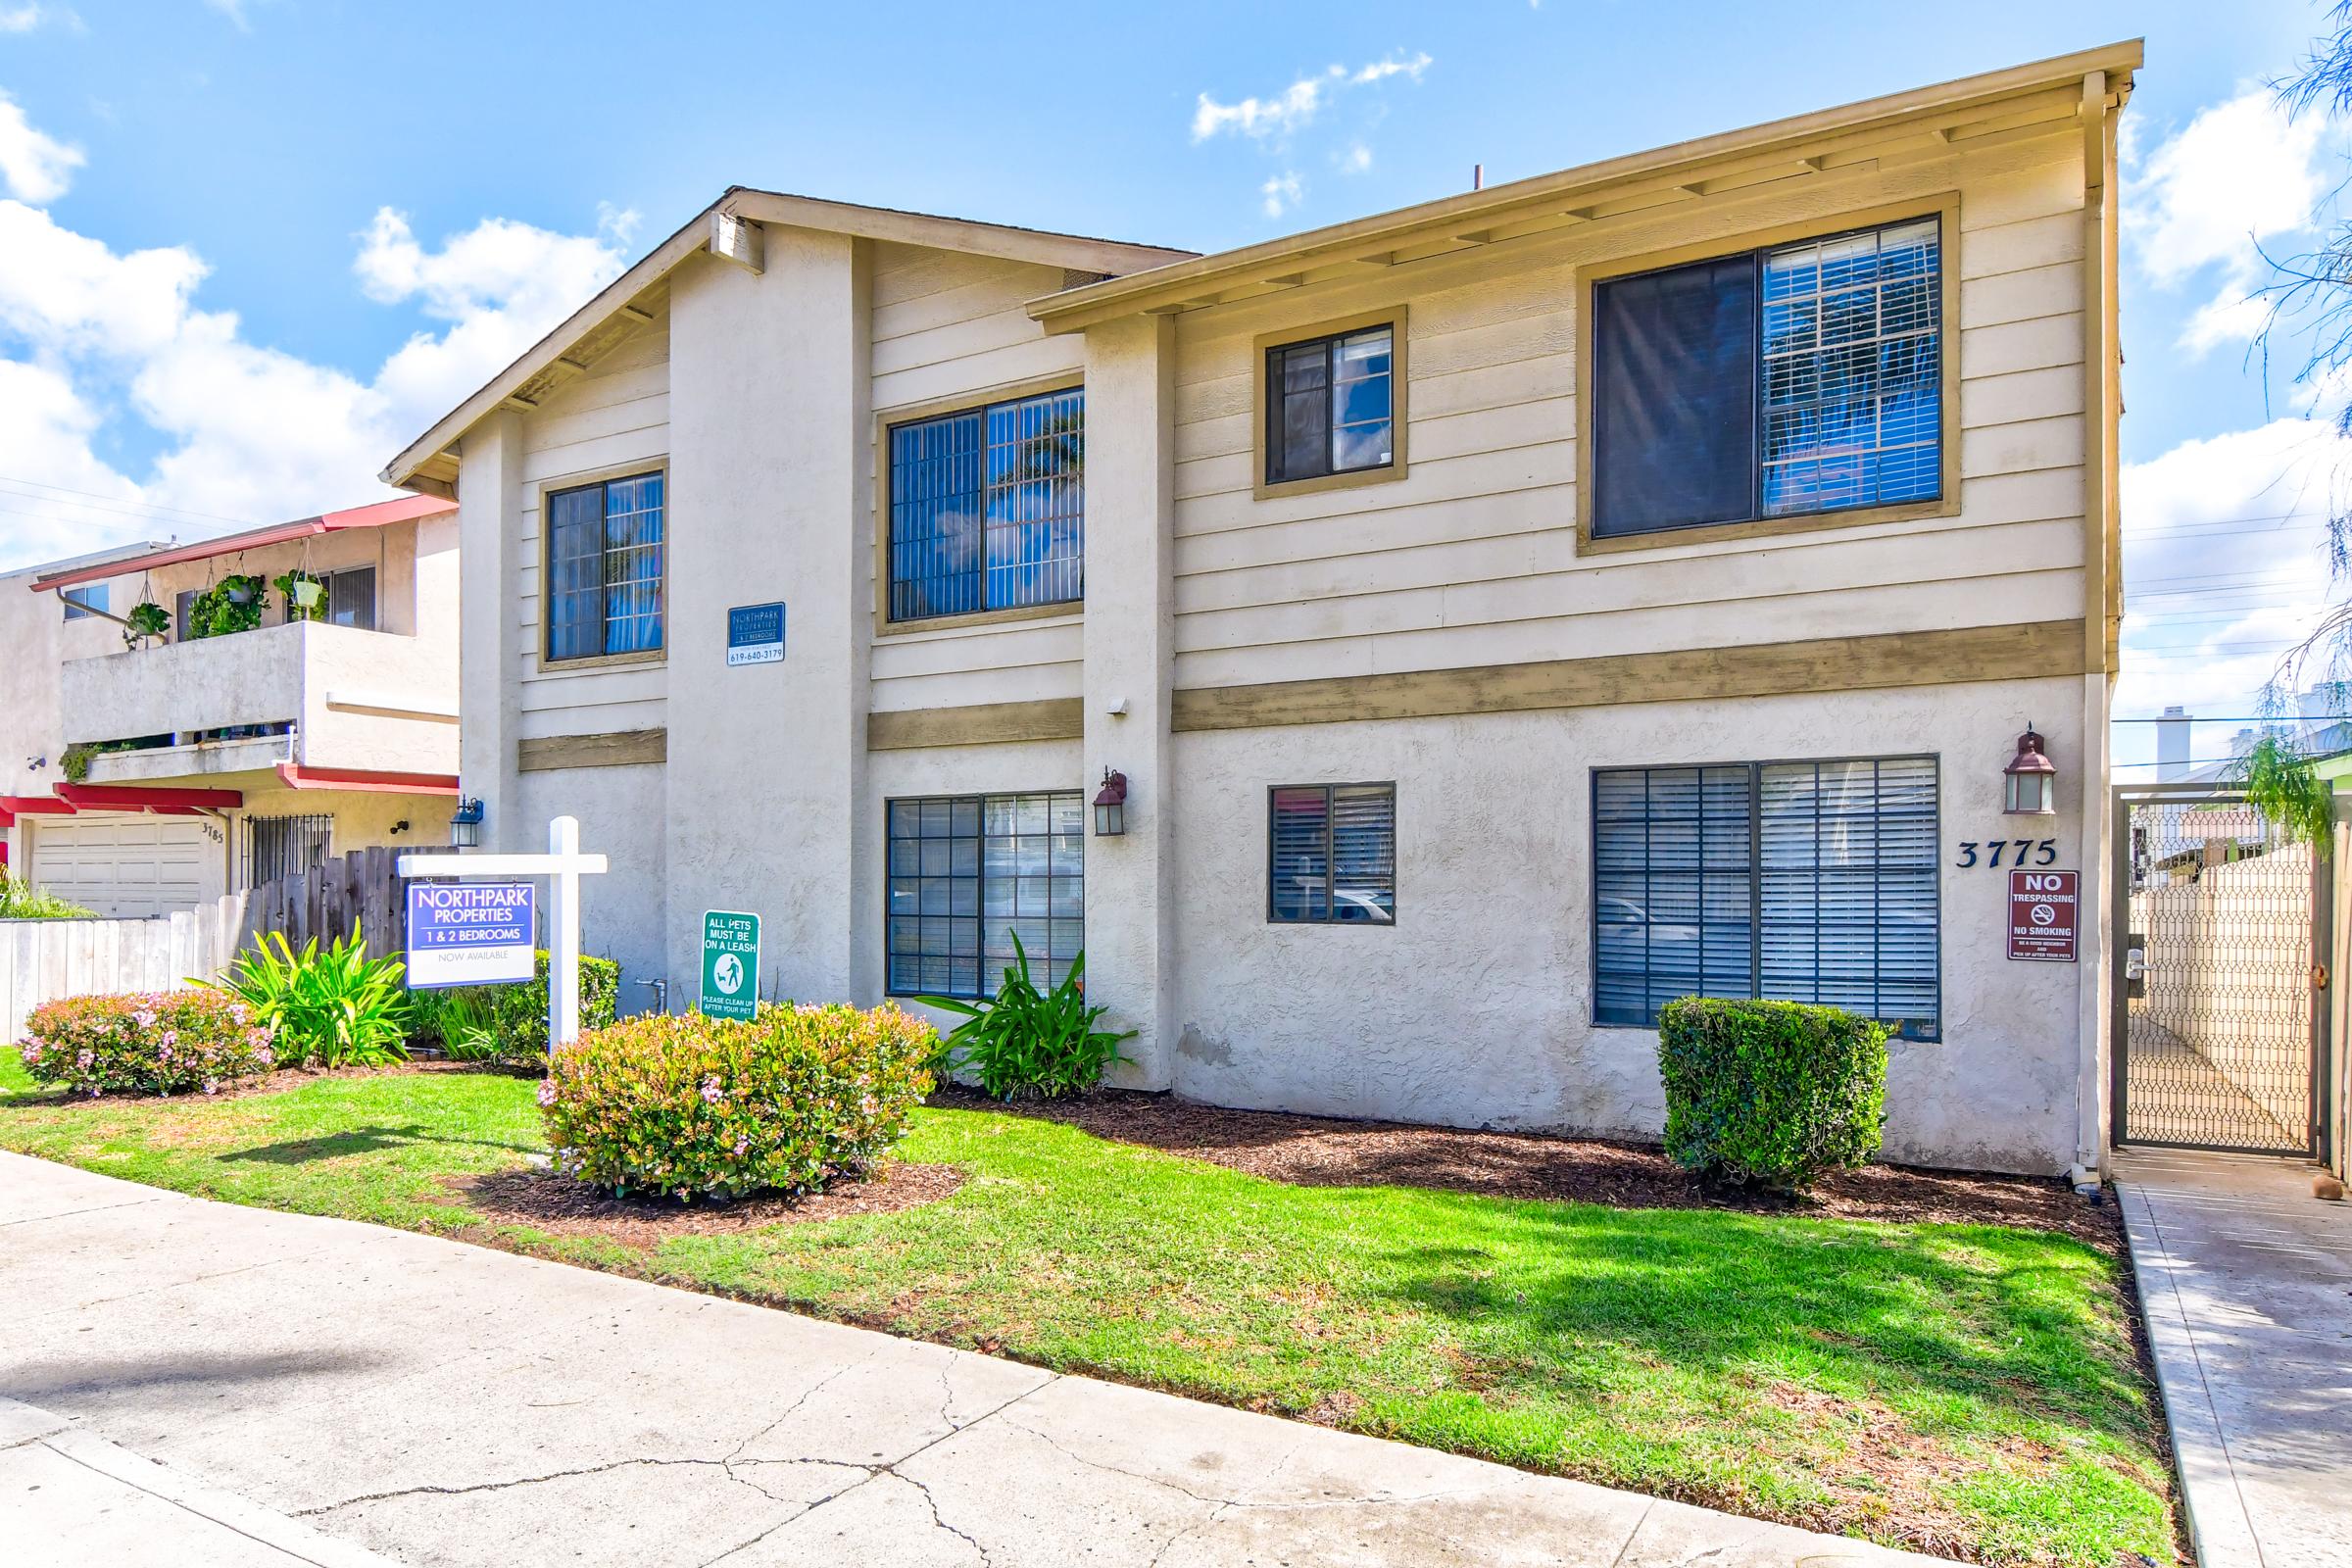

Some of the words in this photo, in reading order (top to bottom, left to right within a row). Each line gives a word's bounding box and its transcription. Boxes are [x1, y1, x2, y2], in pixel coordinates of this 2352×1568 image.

[732, 611, 779, 624] NORTHPARK
[730, 649, 783, 662] 619-640-3179
[202, 822, 223, 844] 3785
[1956, 838, 2056, 868] 3775
[2025, 874, 2062, 891] NO
[417, 889, 529, 908] NORTHPARK
[2013, 893, 2075, 904] TRESPASSING
[434, 907, 514, 923] PROPERTIES
[709, 918, 725, 929] ALL
[728, 918, 752, 931] PETS
[426, 931, 432, 943] 1
[436, 931, 446, 942] &
[448, 930, 457, 942] 2
[459, 928, 520, 941] BEDROOMS
[710, 929, 734, 940] MUST
[737, 931, 750, 942] BE
[2014, 926, 2027, 935] NO
[2029, 926, 2072, 937] SMOKING
[705, 939, 717, 950] ON
[719, 941, 726, 951] A
[727, 942, 757, 953] LEASH
[438, 953, 465, 962] NOW
[467, 950, 509, 961] AVAILABLE
[703, 996, 724, 1004] PLEASE
[725, 998, 745, 1006] CLEAN
